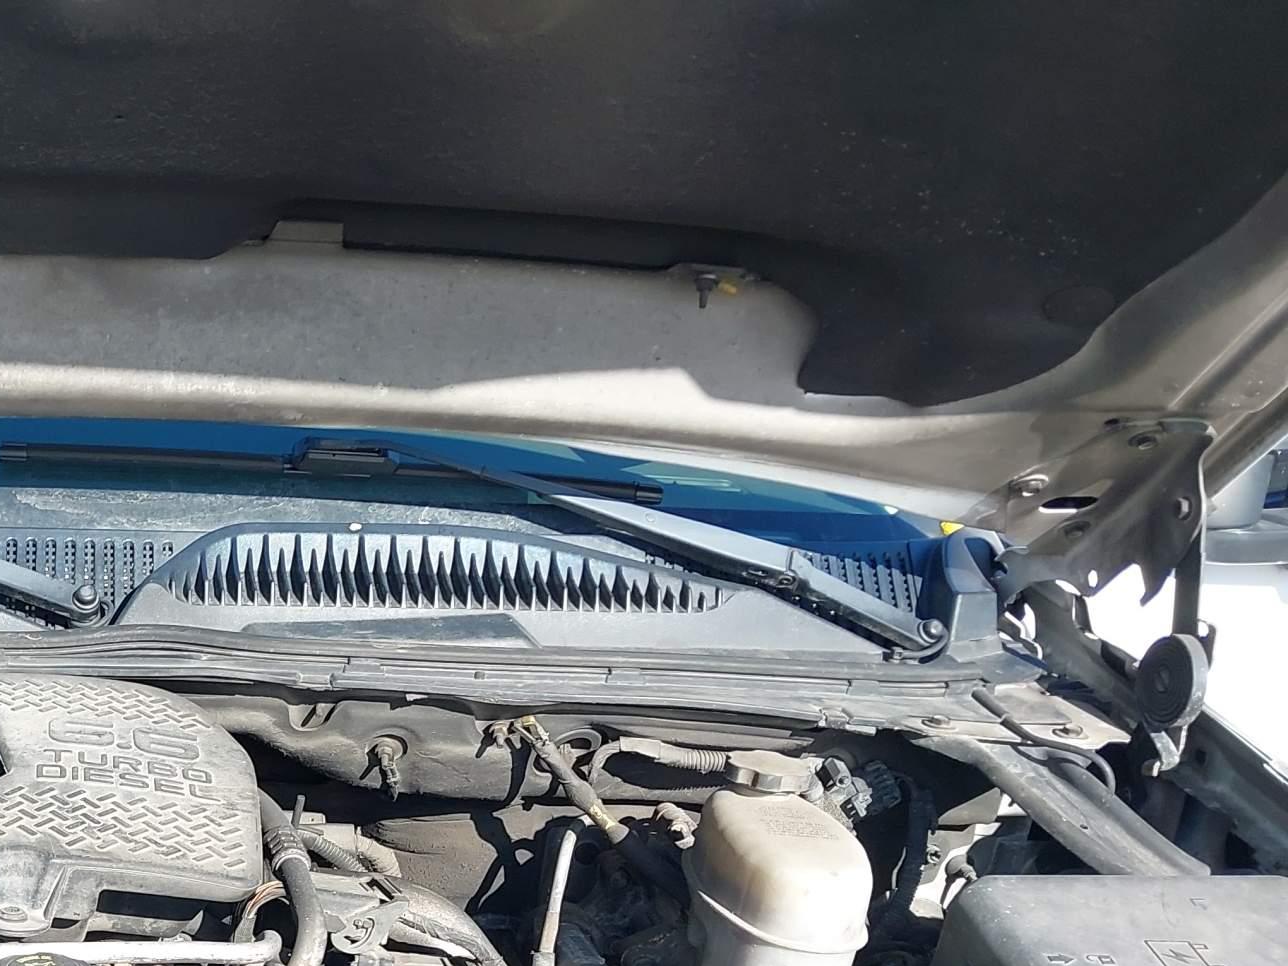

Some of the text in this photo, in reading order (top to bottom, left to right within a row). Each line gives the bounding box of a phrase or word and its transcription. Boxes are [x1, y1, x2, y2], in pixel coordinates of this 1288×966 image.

[48, 717, 201, 762] 6.6
[35, 763, 222, 802] DIESEL
[43, 748, 213, 785] TURBO
